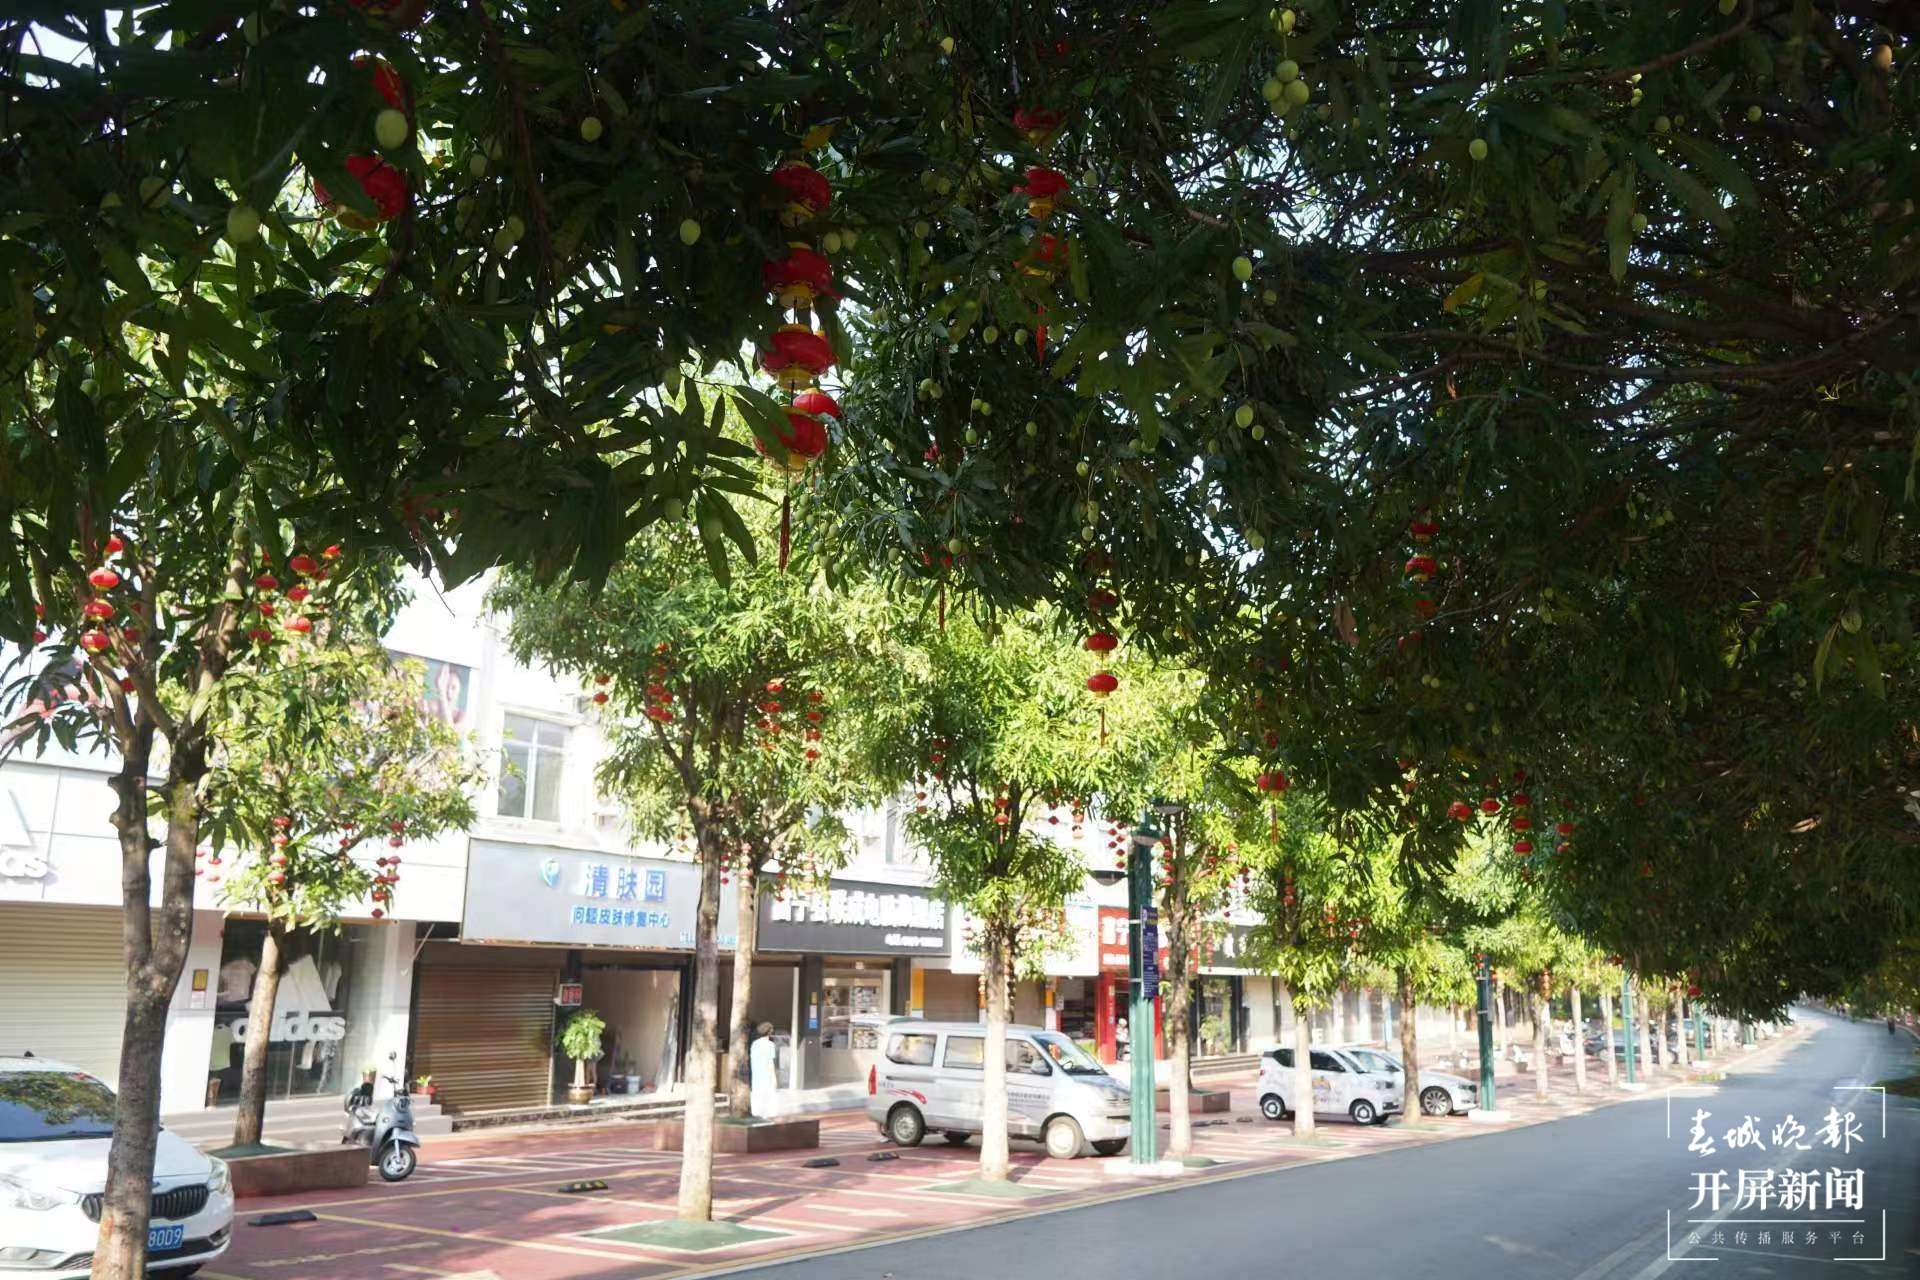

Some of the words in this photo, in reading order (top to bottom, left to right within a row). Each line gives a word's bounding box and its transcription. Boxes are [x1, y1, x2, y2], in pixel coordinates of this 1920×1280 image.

[584, 864, 666, 902] 清肤园
[231, 1009, 346, 1041] aidas
